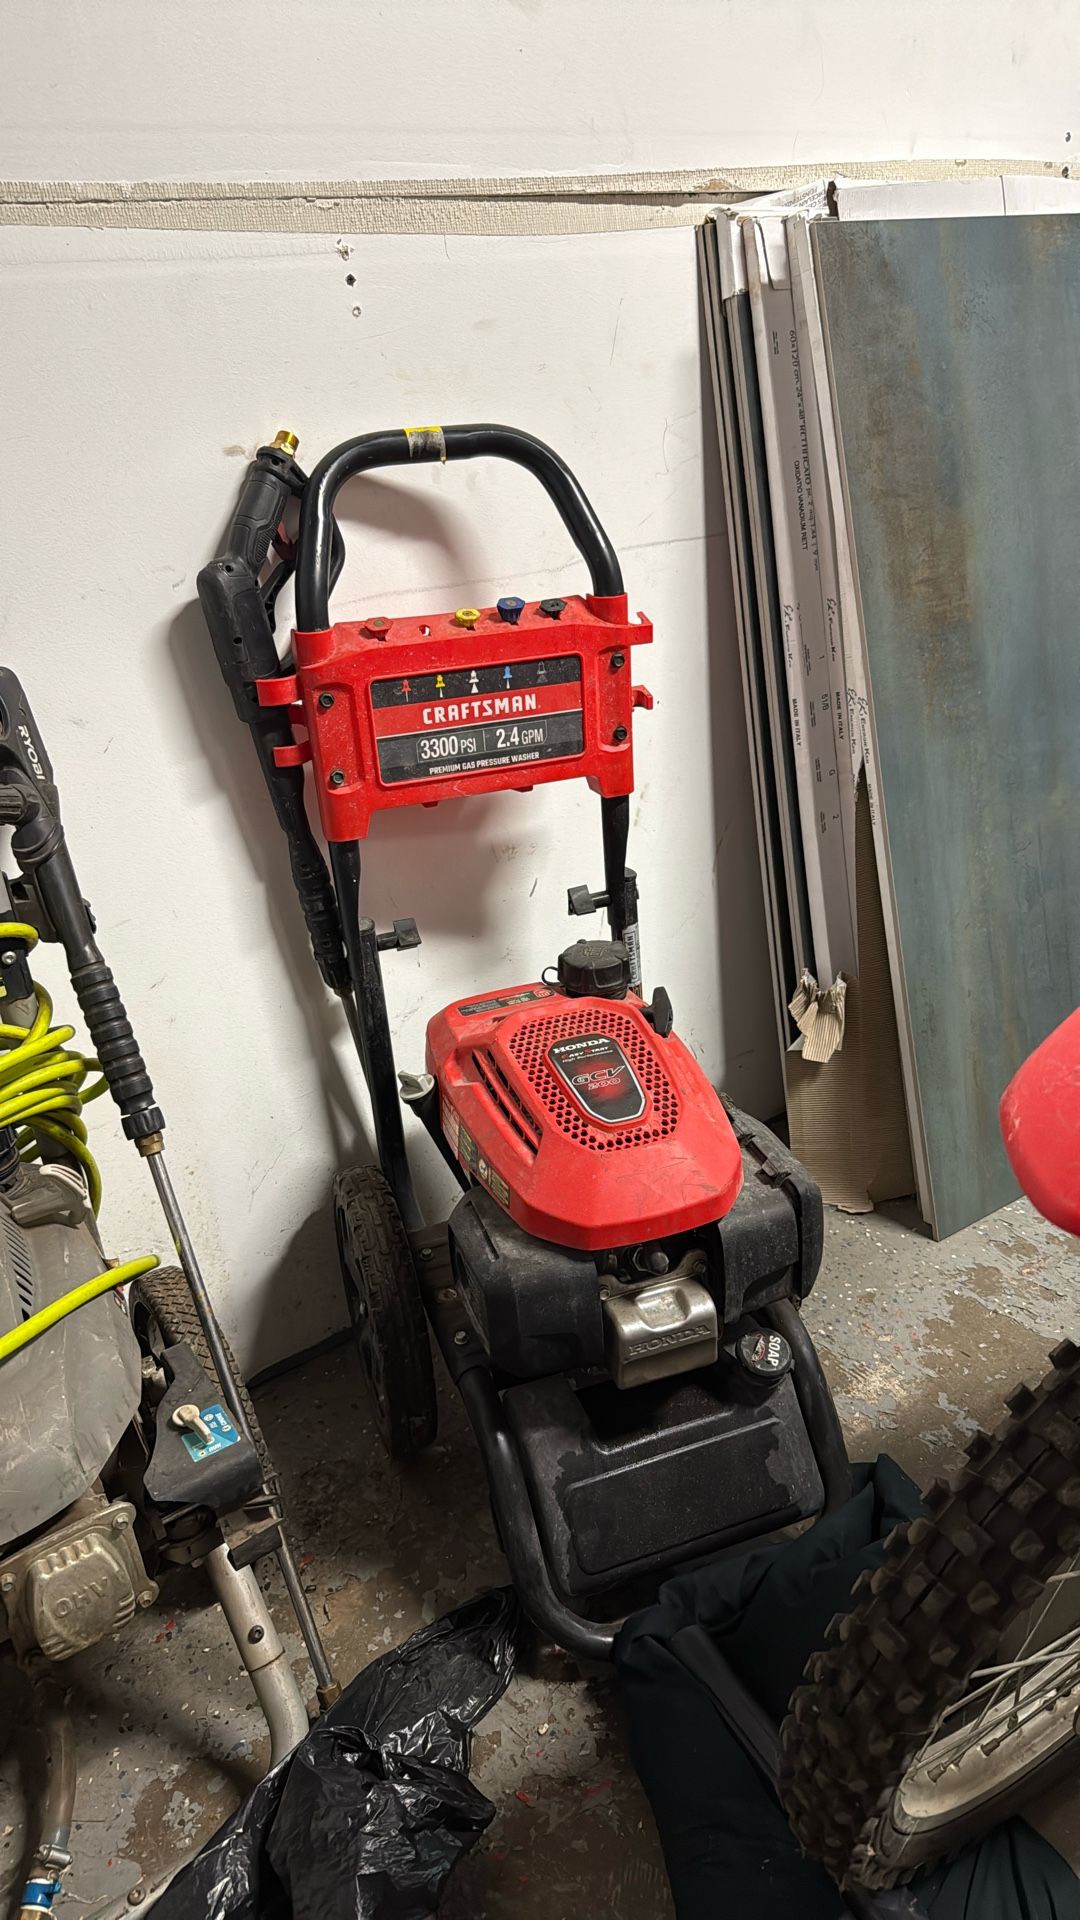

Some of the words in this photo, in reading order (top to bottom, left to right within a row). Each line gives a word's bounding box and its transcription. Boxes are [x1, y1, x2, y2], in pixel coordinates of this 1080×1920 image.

[794, 460, 803, 493] OXIDATIO
[798, 494, 806, 531] VANADIUM
[422, 693, 537, 725] CRAFTSMAN
[794, 719, 800, 727] IN
[837, 712, 843, 720] IN
[17, 724, 46, 780] RYOBI
[420, 735, 459, 760] 3300
[460, 737, 477, 754] PSI
[496, 726, 520, 748] 2.4
[521, 728, 544, 745] GPM
[429, 763, 461, 775] PREMIUM
[462, 761, 476, 770] GAS
[476, 756, 511, 768] PRESSURE
[511, 751, 540, 763] WASHER
[552, 1038, 611, 1054] HONDA
[571, 1065, 626, 1086] GCV
[588, 1078, 621, 1091] 200
[628, 1324, 712, 1357] HONDA
[767, 1335, 781, 1367] SOAP
[54, 1575, 108, 1619] OHV
